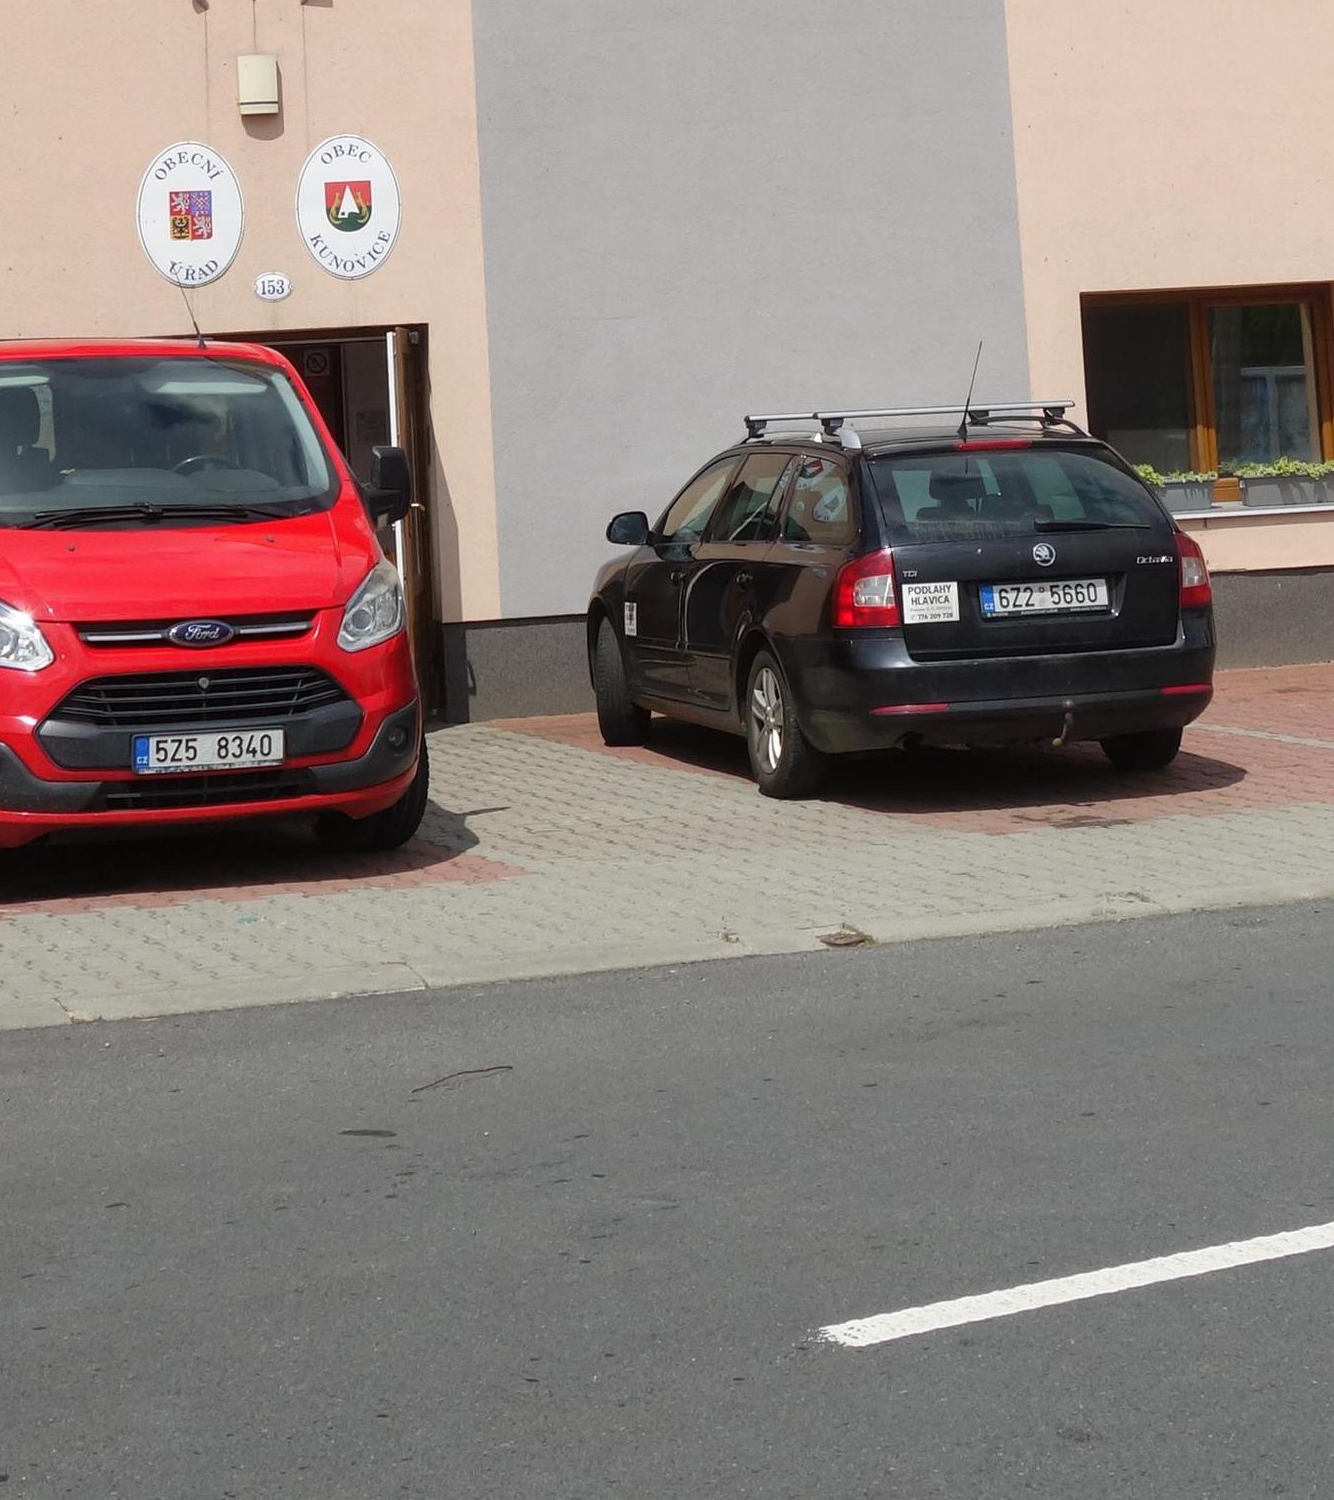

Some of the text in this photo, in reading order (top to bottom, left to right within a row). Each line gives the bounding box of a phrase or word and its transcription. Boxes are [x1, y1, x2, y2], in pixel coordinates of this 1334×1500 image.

[320, 143, 372, 165] OBEC
[155, 151, 224, 180] OBECNÍ
[310, 231, 391, 273] KUNOVICE
[169, 259, 219, 281] ÚŘAD
[260, 279, 285, 295] 153
[908, 584, 951, 595] PODLAHY
[911, 596, 950, 605] HLAVICA
[999, 582, 1097, 608] 6Z2 5660
[185, 624, 220, 640] Ford
[156, 734, 272, 762] 5Z5 8340
[137, 756, 149, 764] CZ
